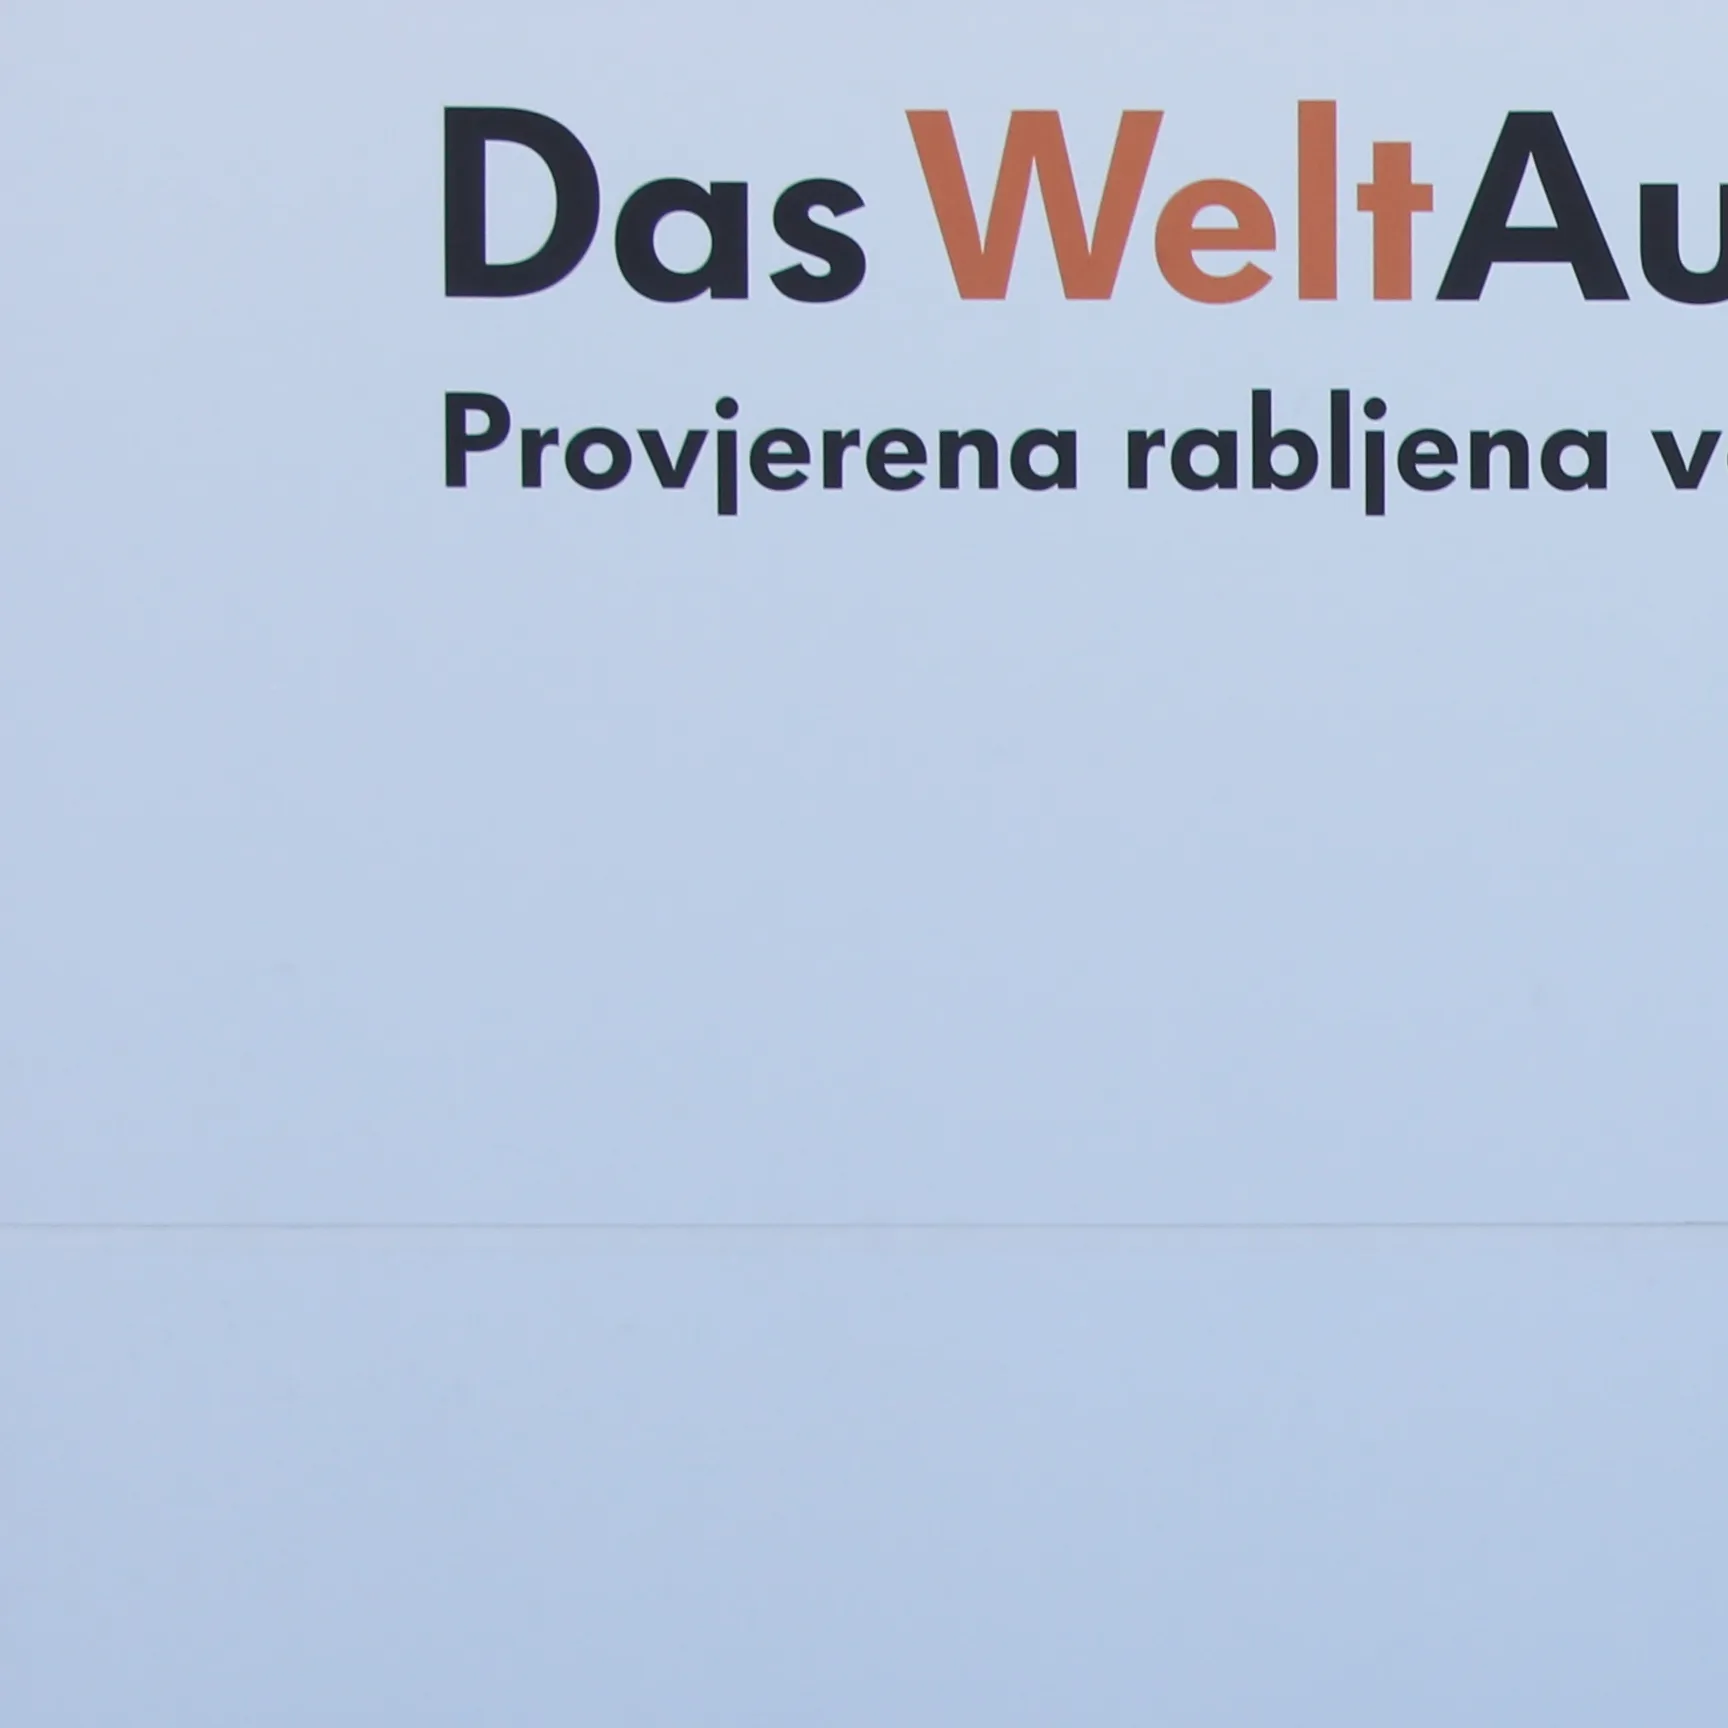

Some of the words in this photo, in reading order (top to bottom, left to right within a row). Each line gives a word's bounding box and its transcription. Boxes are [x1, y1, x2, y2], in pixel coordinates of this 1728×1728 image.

[444, 106, 867, 304] Das
[444, 389, 1078, 517] Provjerena
[1127, 389, 1608, 517] rabljena
